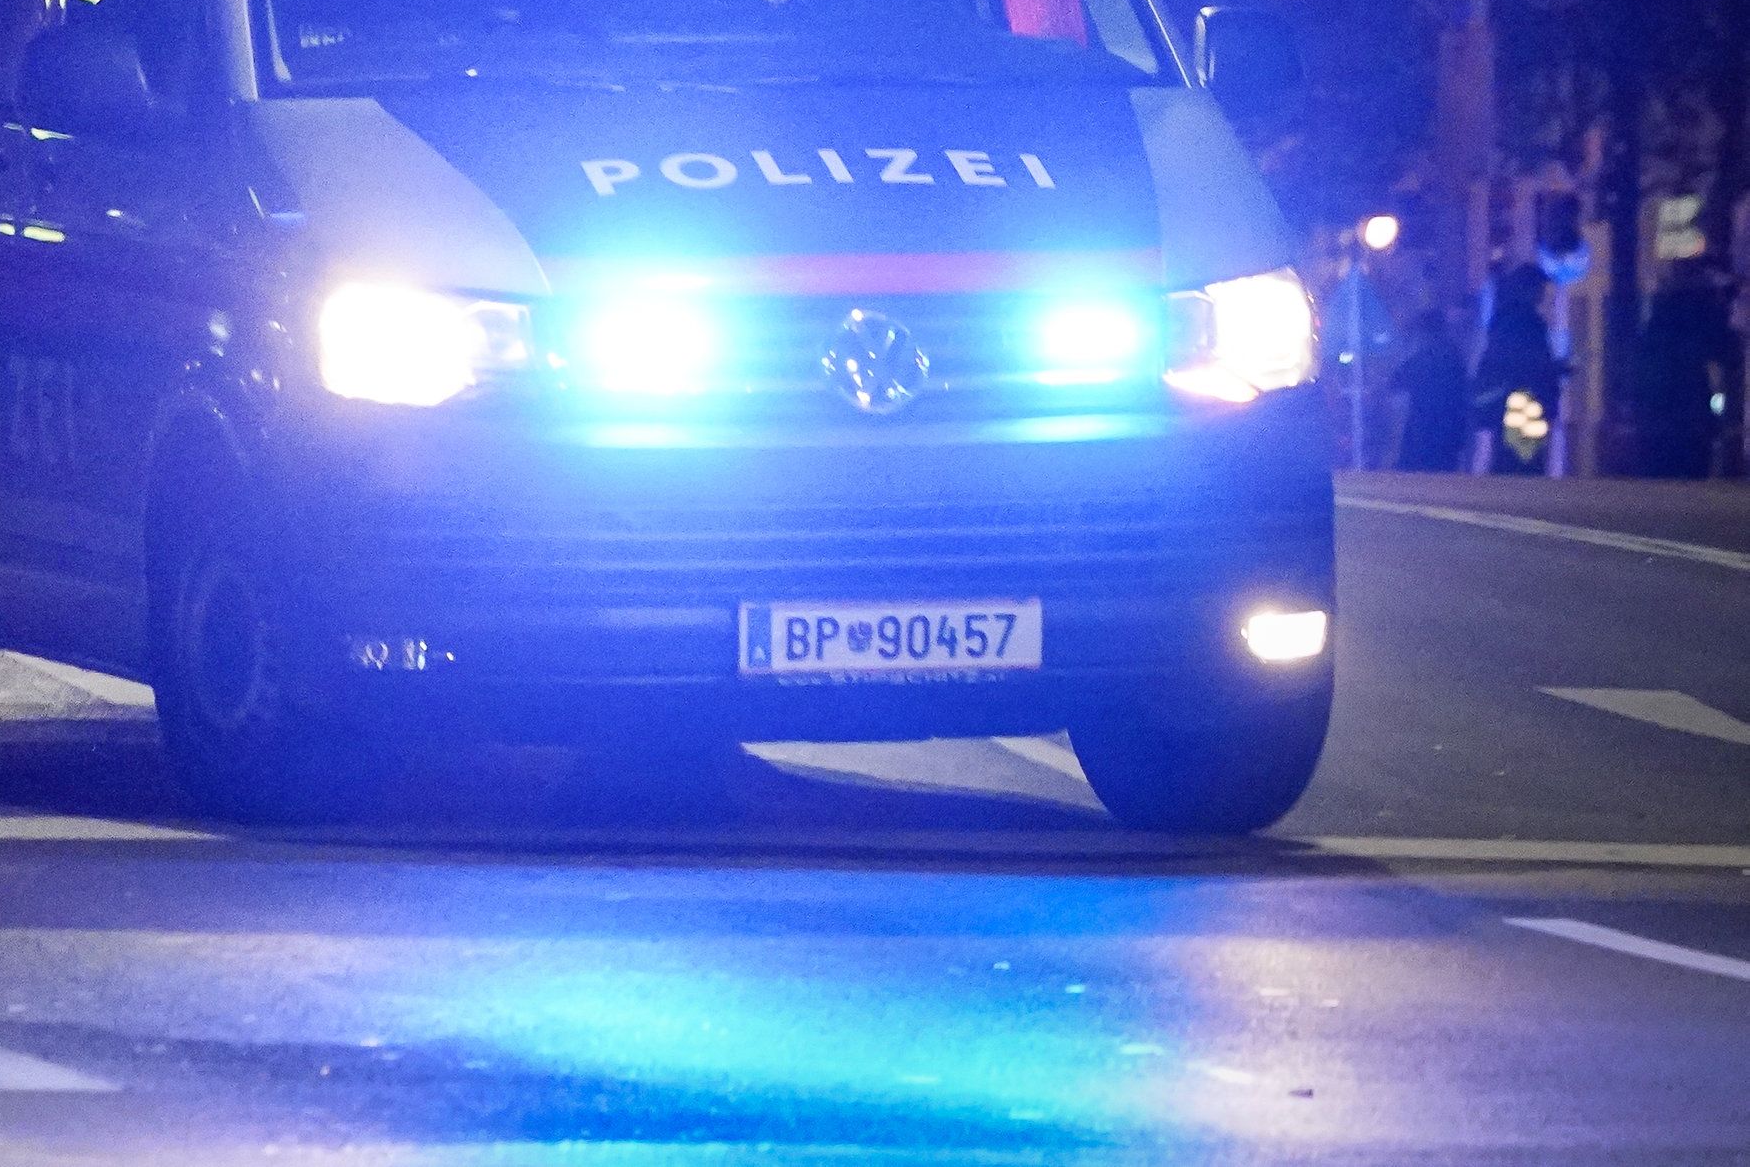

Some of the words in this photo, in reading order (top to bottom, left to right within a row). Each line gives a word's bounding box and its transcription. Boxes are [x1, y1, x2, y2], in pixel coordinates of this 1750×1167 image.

[579, 147, 1056, 197] POLIZEI
[785, 615, 840, 661] BP
[876, 612, 1018, 660] 90457
